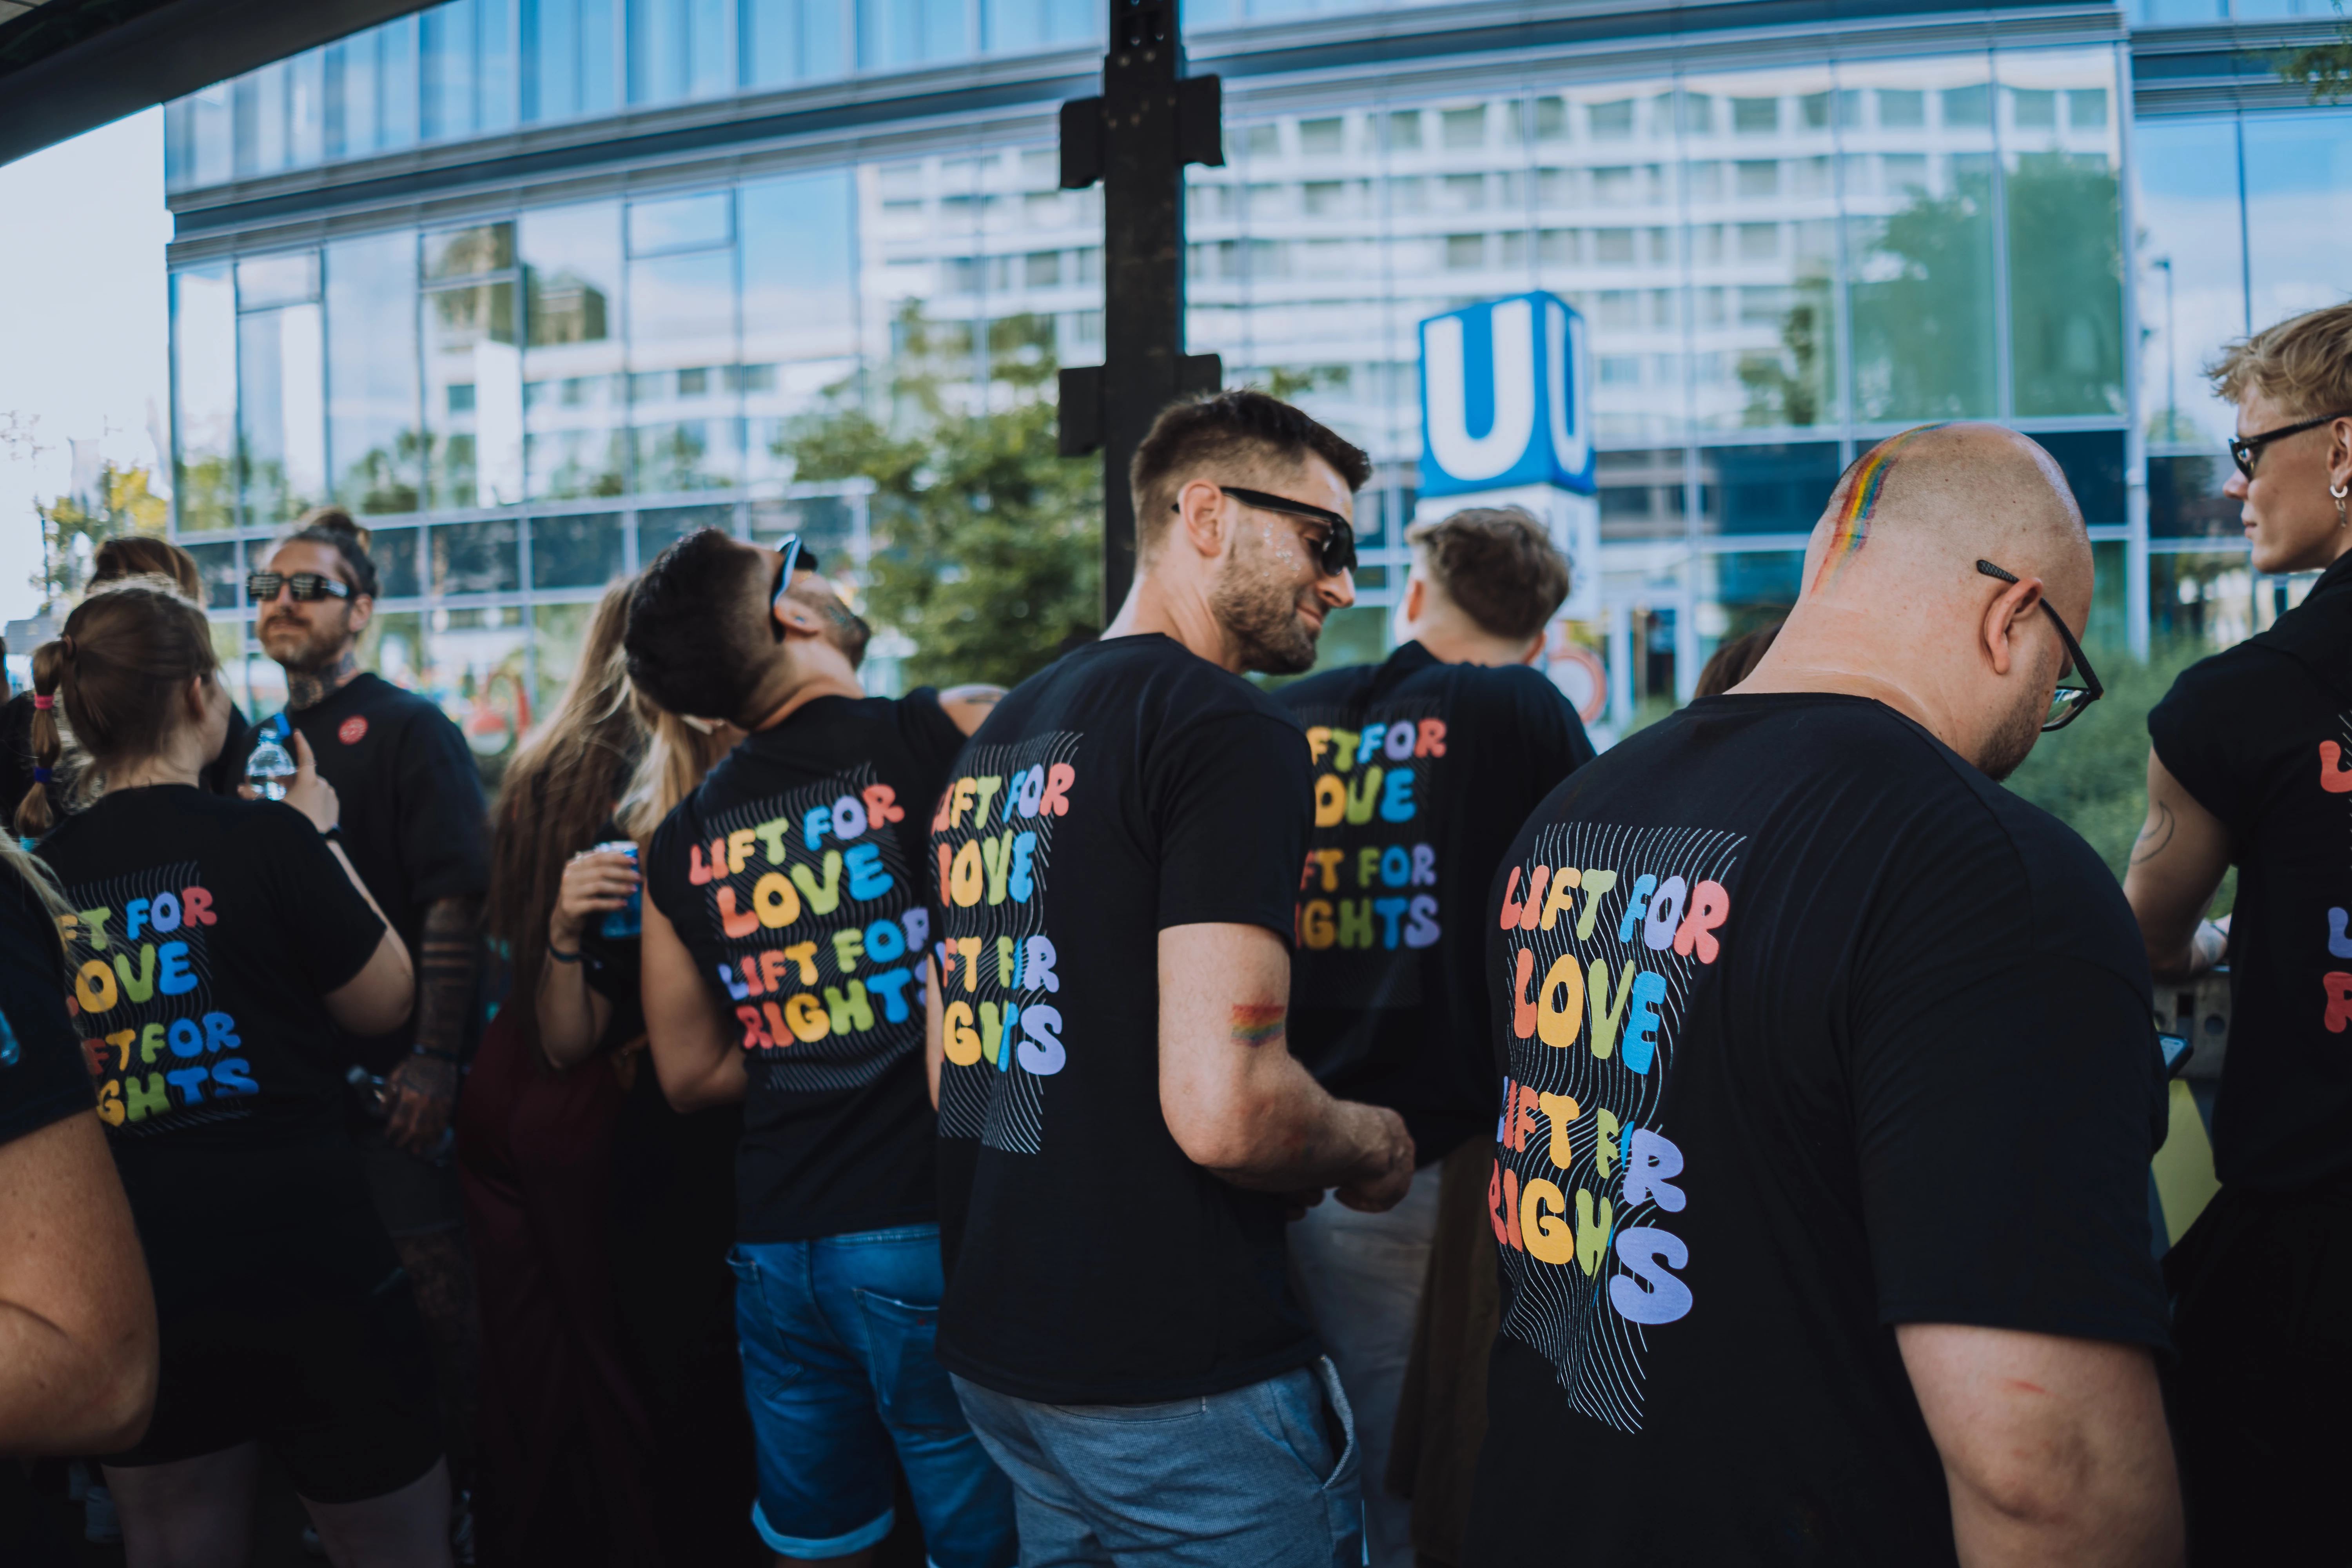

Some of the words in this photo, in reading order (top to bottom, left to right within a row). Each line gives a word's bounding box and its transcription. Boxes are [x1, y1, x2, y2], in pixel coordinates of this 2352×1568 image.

[1424, 298, 1535, 481] U
[1545, 299, 1586, 478] U
[1307, 726, 1360, 772] FT
[1357, 718, 1446, 764] FOR
[1002, 762, 1075, 824] FOR
[1314, 765, 1417, 827] OVE
[689, 817, 789, 886] LIFT
[803, 784, 905, 851] FOR
[1300, 848, 1344, 893] FT
[1358, 843, 1436, 889] FOR
[54, 906, 111, 953] FT
[126, 886, 218, 940] FOR
[716, 842, 894, 938] LOVE
[1295, 893, 1441, 951] GHTS
[1500, 865, 1618, 941] LIFT
[1619, 874, 1730, 964] FOR
[66, 941, 198, 1017] OVE
[717, 941, 818, 1001] LIFT
[997, 935, 1060, 993] FR
[80, 1029, 136, 1074] FT
[141, 1011, 241, 1064] FOR
[1514, 947, 1667, 1075] LOVE
[96, 1058, 260, 1127] GHTS
[1596, 1107, 1686, 1212] FR
[1488, 1158, 1693, 1325] RIGHS
